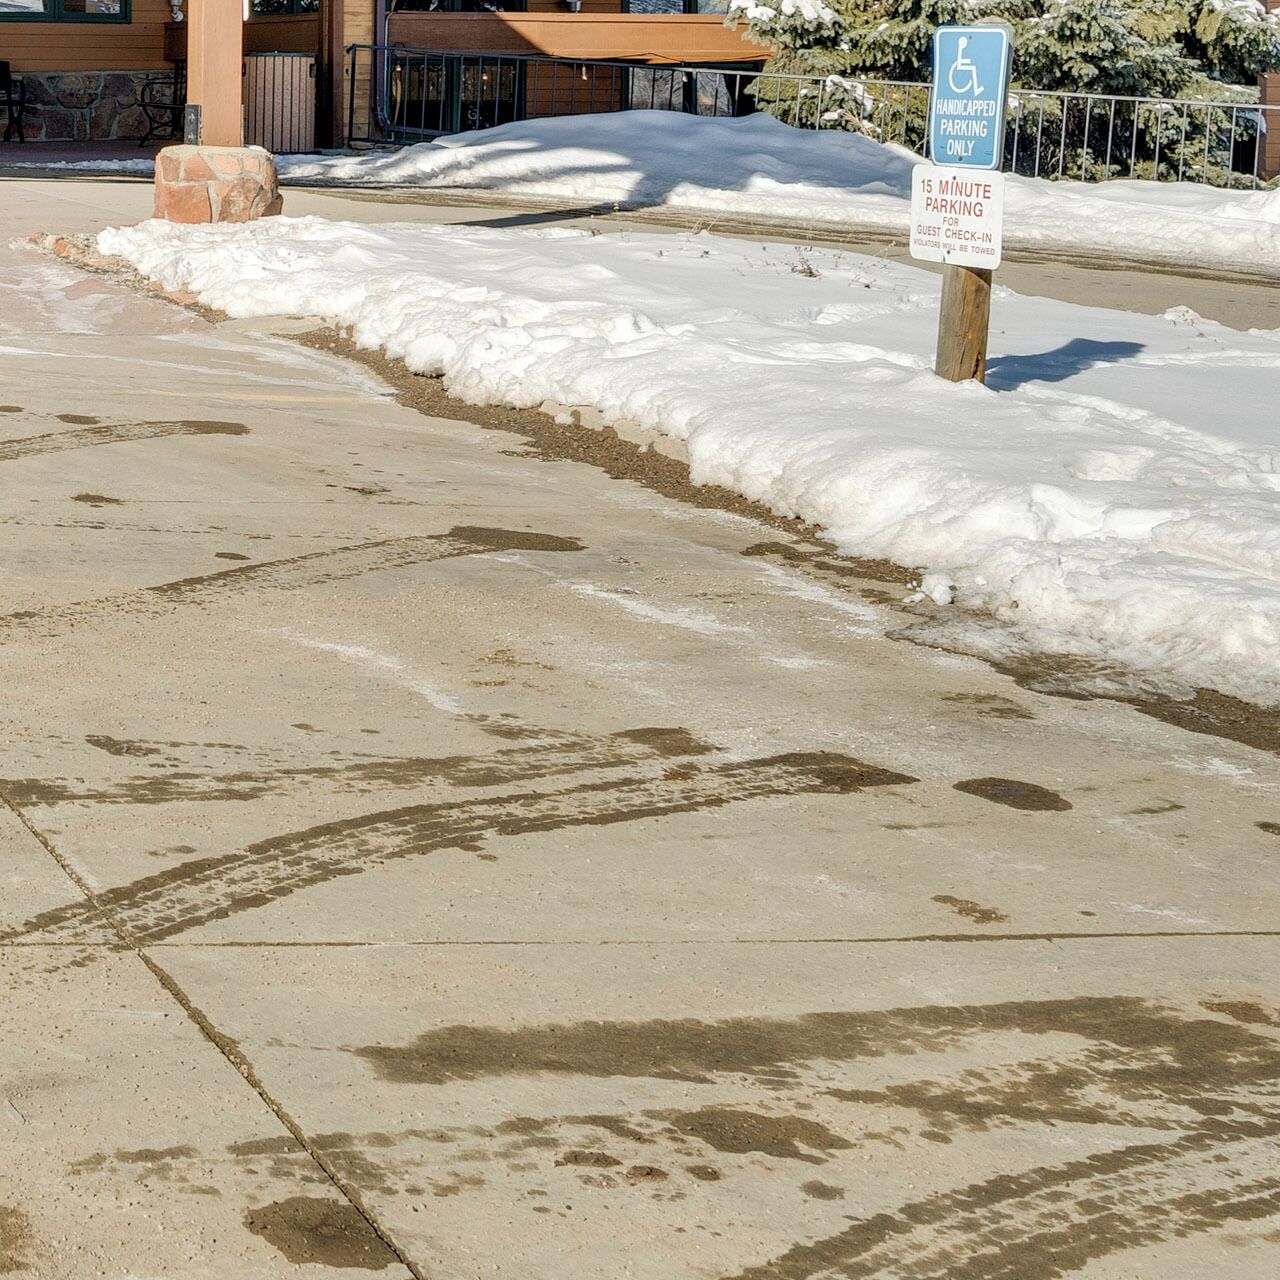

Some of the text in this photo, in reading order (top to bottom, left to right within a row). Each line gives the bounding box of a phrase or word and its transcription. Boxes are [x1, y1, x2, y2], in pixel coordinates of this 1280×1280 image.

[936, 99, 996, 116] HANDICAPPED
[941, 119, 988, 137] PARKING
[947, 139, 975, 156] ONLY
[921, 178, 992, 199] 15 MINUTE
[925, 197, 983, 217] PARKING
[942, 217, 960, 227] FOR
[917, 224, 992, 244] GUEST CHECK-IN
[913, 238, 996, 256] VIOLATORS WILL BE TOWED
